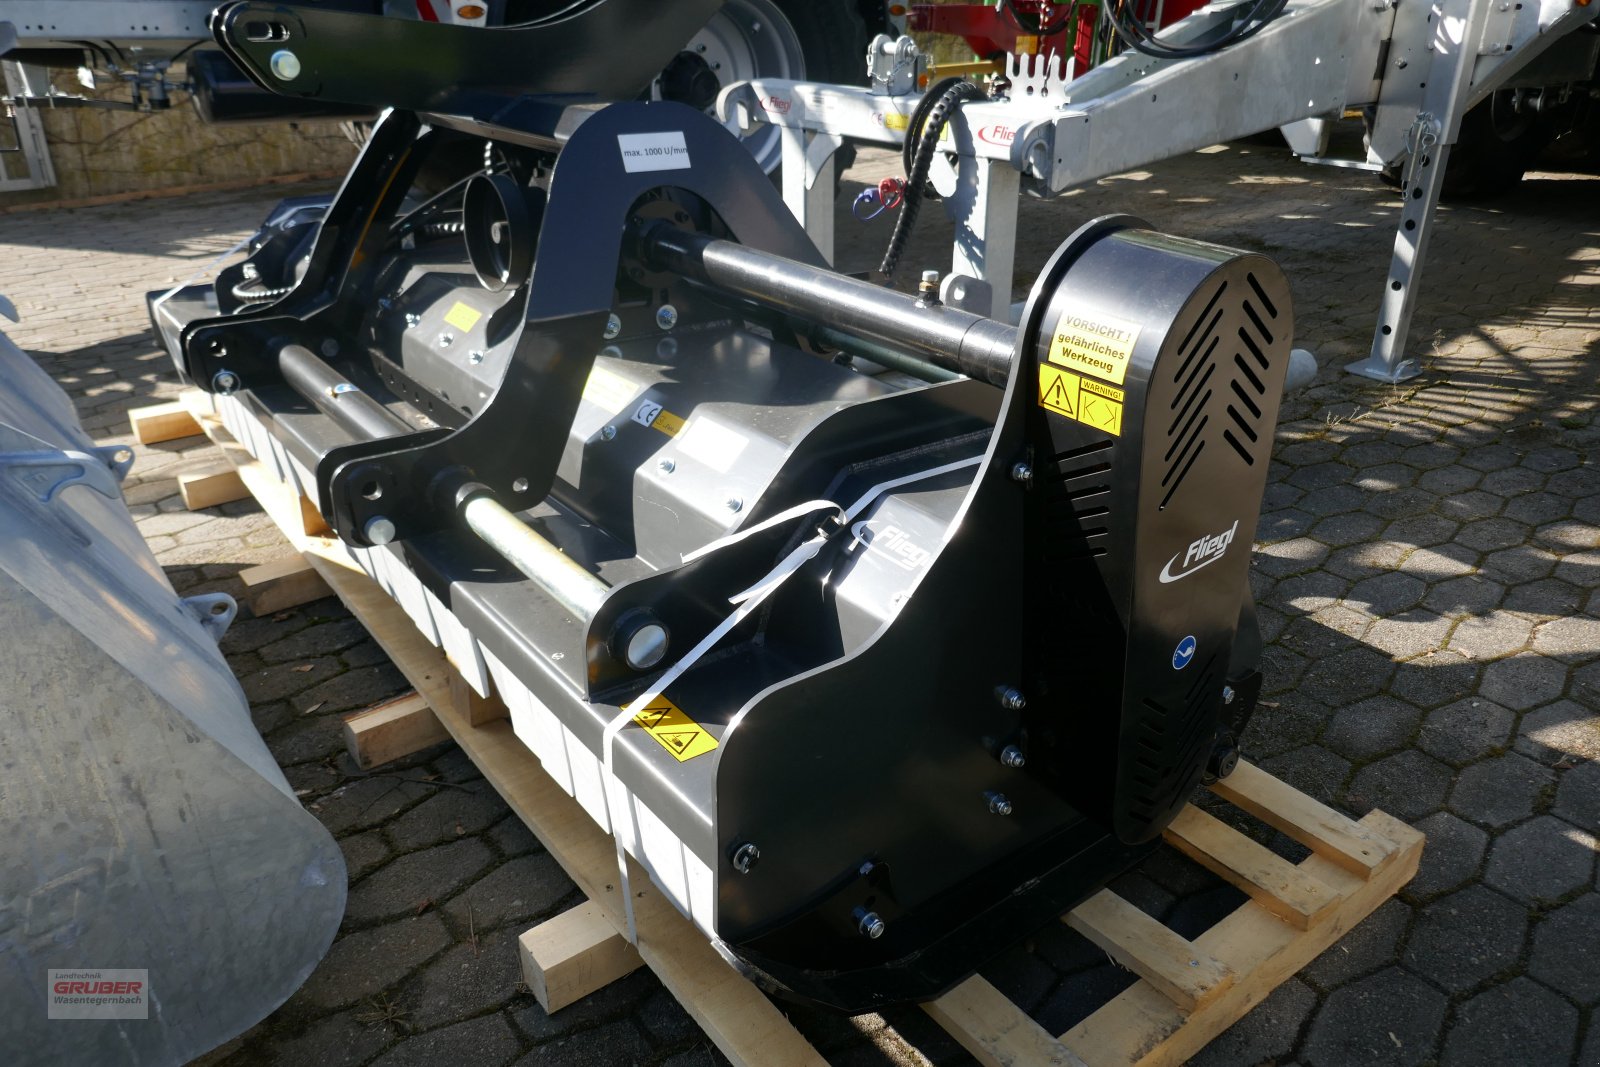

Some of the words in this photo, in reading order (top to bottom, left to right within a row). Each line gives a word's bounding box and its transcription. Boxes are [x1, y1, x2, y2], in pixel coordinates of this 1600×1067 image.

[769, 95, 792, 113] Fliegl
[992, 125, 1017, 141] Flie
[624, 149, 642, 157] max.
[644, 147, 662, 156] 1000
[1066, 315, 1125, 340] VORSICHT
[1058, 332, 1125, 360] gefährliches
[1062, 346, 1114, 374] Werkzeug
[1083, 380, 1121, 399] WARNING!
[1182, 519, 1239, 568] Fliegl
